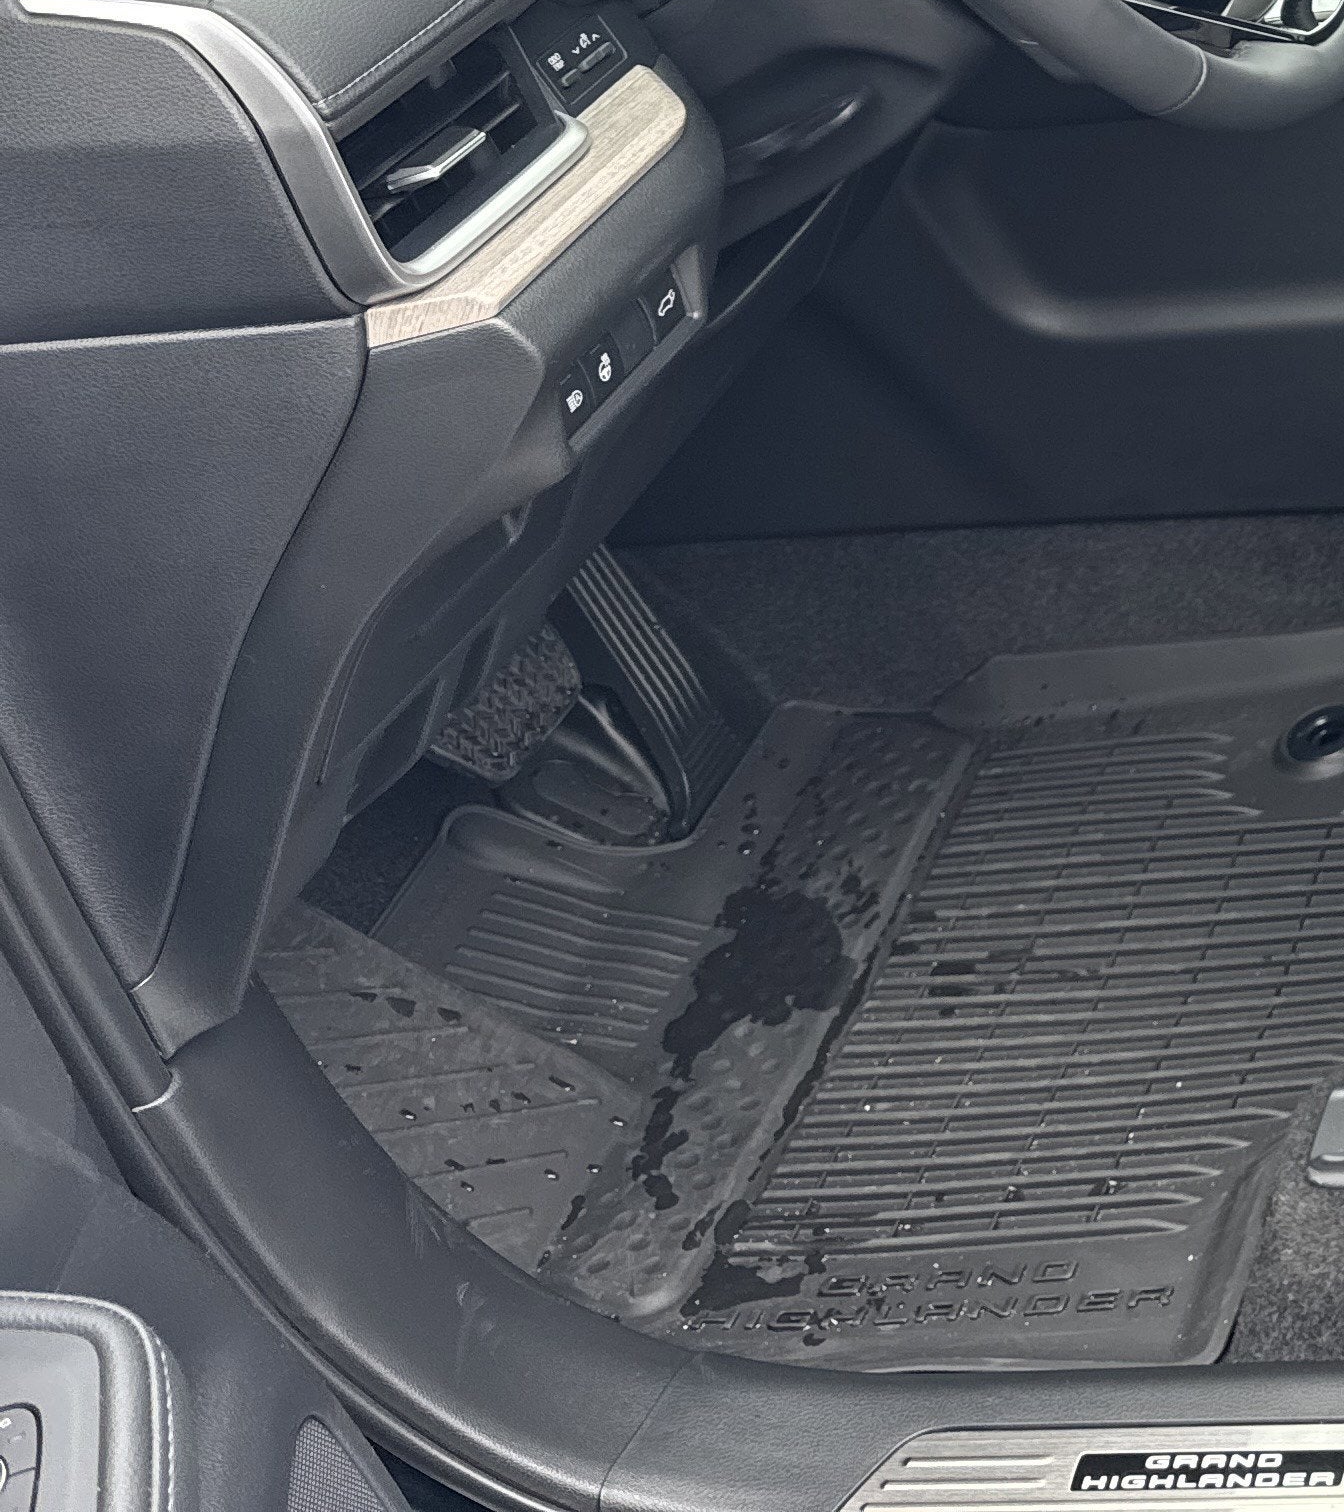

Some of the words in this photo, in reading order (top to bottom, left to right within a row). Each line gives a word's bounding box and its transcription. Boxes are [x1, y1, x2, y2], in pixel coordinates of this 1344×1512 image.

[816, 1261, 1079, 1298] GRAND
[684, 1286, 1175, 1331] HIGHLANDER
[1145, 1453, 1283, 1469] GRAND
[1081, 1472, 1335, 1489] HIGHLANDER
